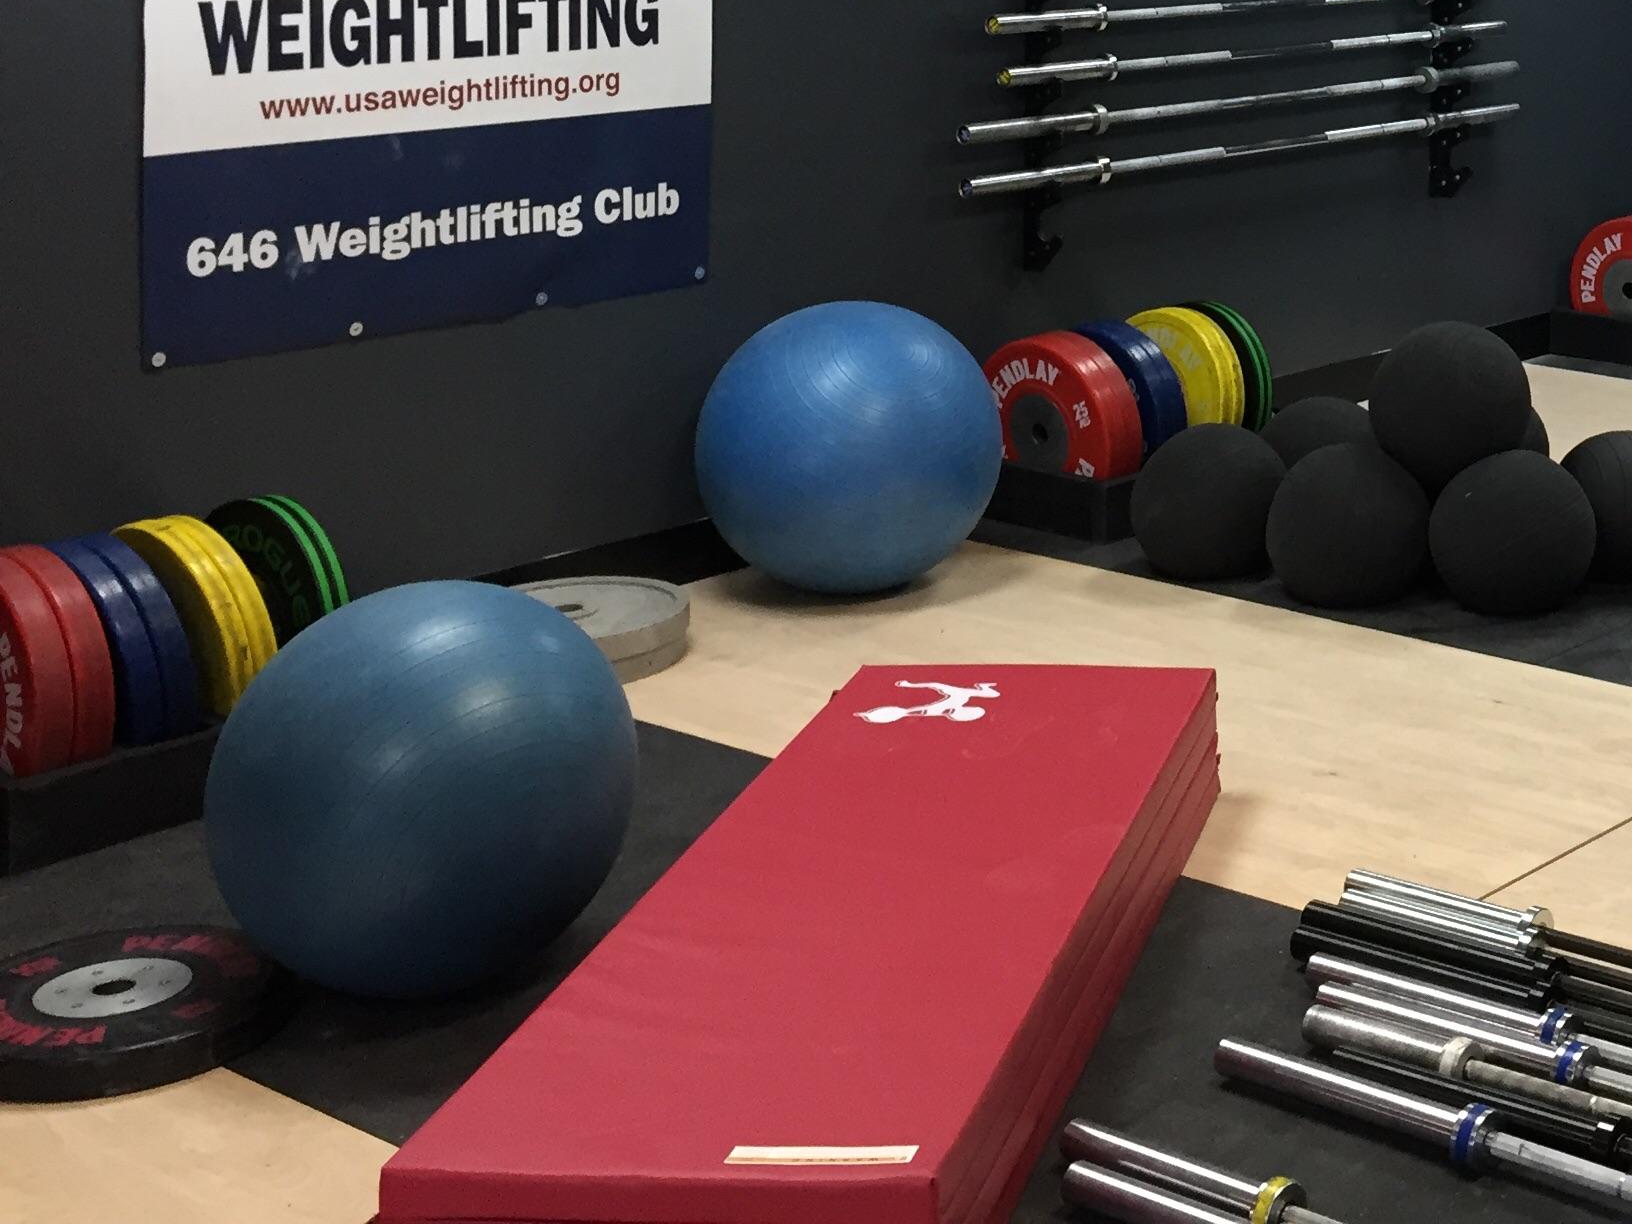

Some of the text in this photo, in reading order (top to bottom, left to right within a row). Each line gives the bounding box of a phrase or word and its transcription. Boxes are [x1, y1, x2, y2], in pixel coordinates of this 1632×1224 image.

[259, 72, 622, 120] www.usaweightlifting.org
[186, 182, 681, 278] 646 Weightlifting Club
[1580, 231, 1625, 305] PENDLAY
